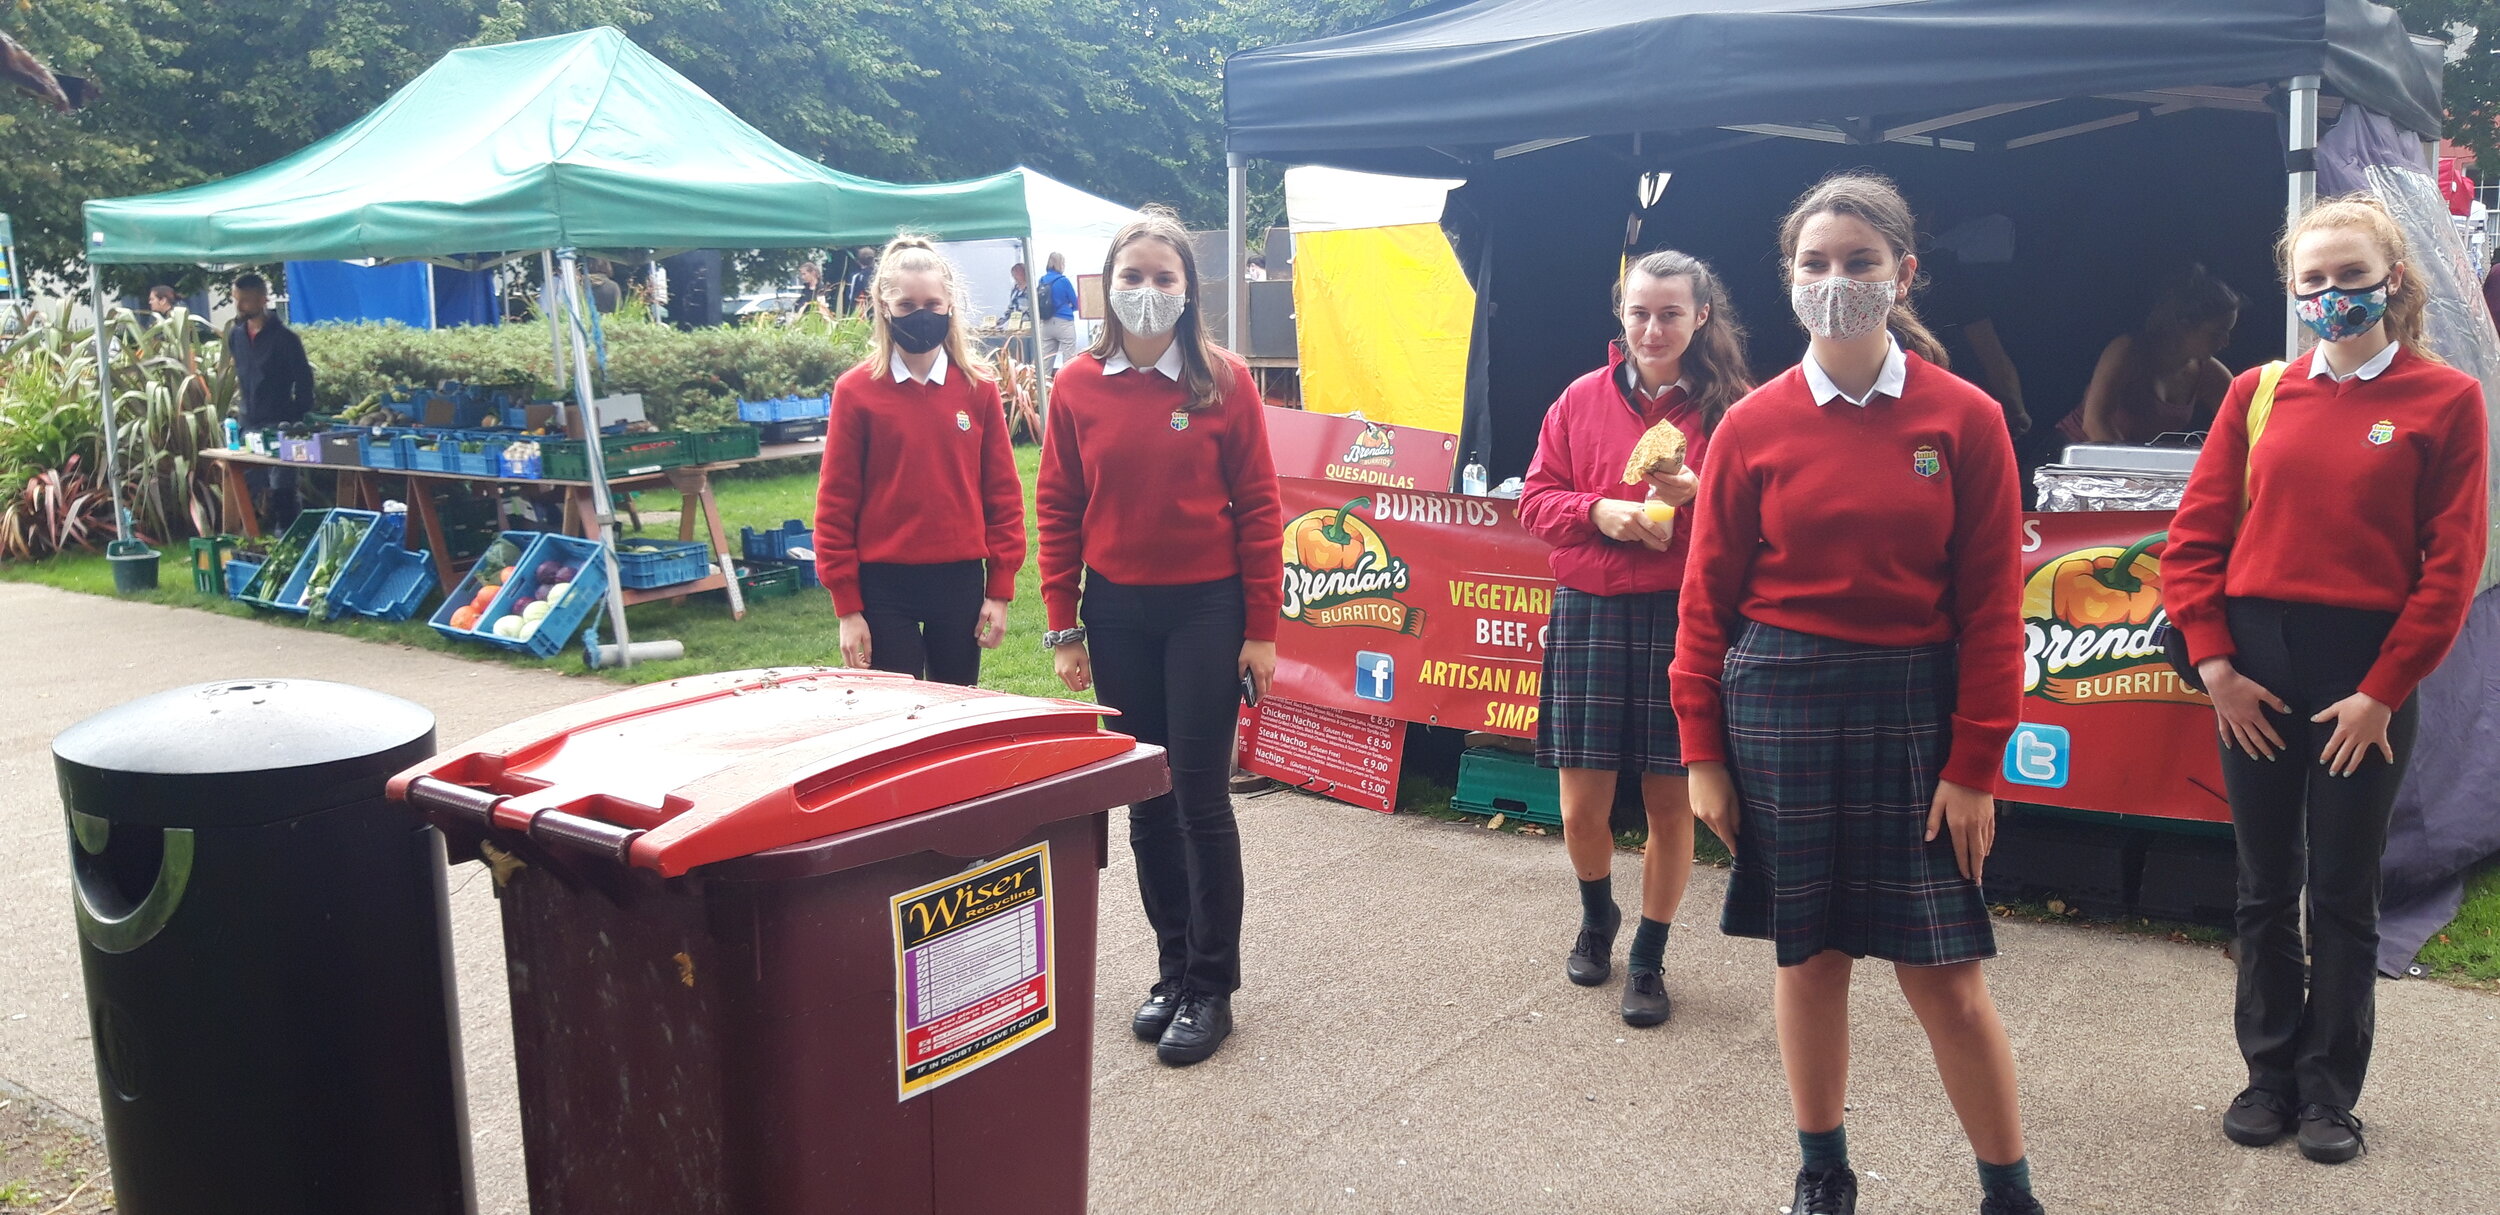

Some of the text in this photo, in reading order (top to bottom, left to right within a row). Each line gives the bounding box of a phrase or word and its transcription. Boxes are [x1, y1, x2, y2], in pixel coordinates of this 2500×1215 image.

[1343, 443, 1394, 462] Brendan's
[1325, 463, 1415, 490] QUESADILLAS
[1374, 492, 1499, 527] BURRITOS
[2022, 519, 2042, 553] S
[1282, 553, 1407, 618] Brendan's
[1449, 580, 1551, 615] VEGETARI
[1320, 603, 1402, 626] BURRITOS
[1476, 618, 1533, 652] BEEF,
[2023, 609, 2170, 692] Brend
[1418, 659, 1542, 697] ARTISAN M
[1260, 705, 1291, 720] Chicken
[1291, 714, 1321, 730] Nachos
[1366, 735, 1373, 744] €
[1372, 737, 1392, 750] 8.50
[1377, 717, 1395, 728] 8.50
[1484, 701, 1539, 732] SIMP
[1258, 726, 1279, 739] Steak
[1278, 732, 1308, 748] Nachos
[1362, 757, 1369, 766] €
[1369, 759, 1388, 772] 9.00
[1254, 747, 1285, 764] Nachips
[1360, 778, 1367, 788] €
[1367, 781, 1386, 794] 5.00
[909, 866, 1035, 936] Wiser
[966, 887, 1036, 918] Recycling
[917, 1064, 926, 1074] IF
[929, 1060, 938, 1070] IN
[941, 1045, 971, 1065] DOUBT
[975, 1041, 979, 1049] ?
[981, 1028, 1007, 1046] LEAVE
[1009, 1024, 1016, 1032] IT
[1018, 1014, 1035, 1028] OUT
